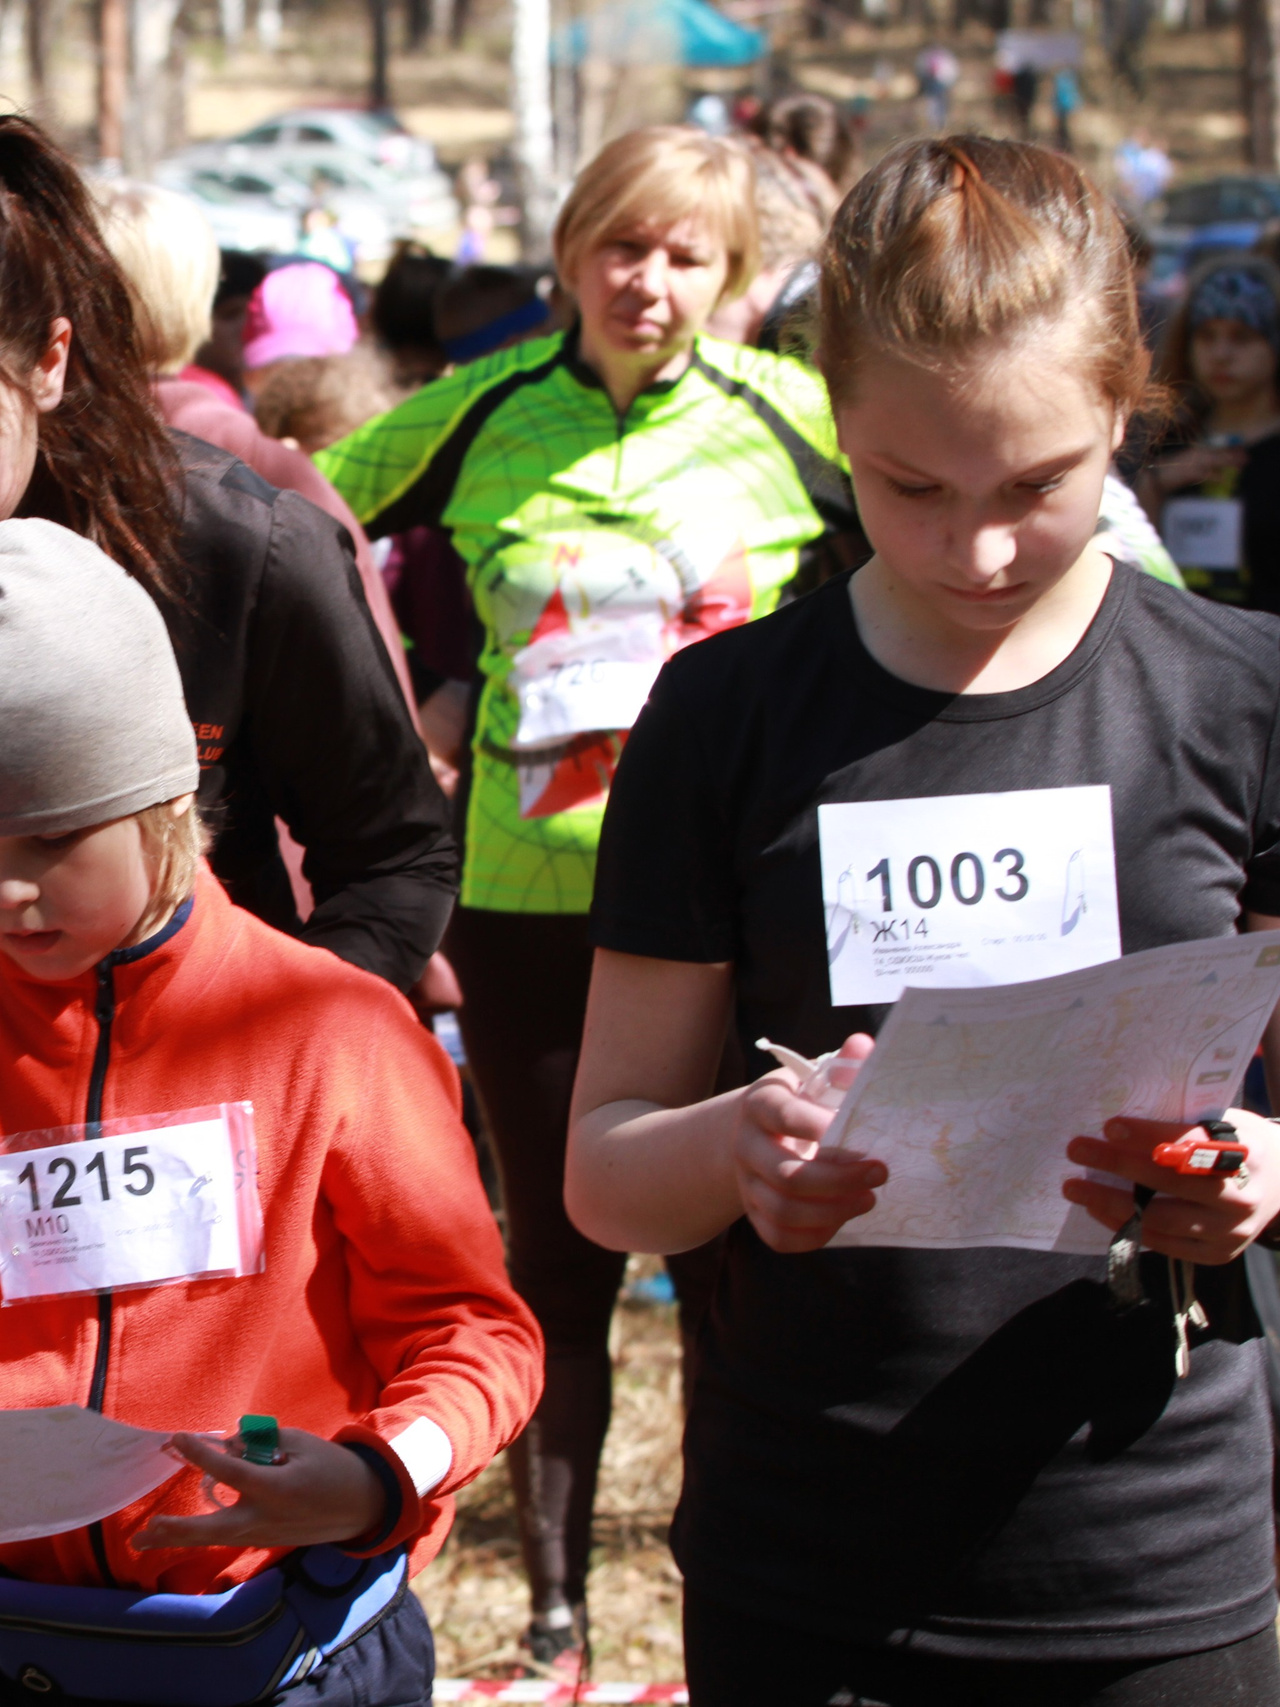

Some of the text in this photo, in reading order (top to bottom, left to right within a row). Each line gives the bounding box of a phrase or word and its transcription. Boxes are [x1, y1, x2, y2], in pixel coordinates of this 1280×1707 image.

[866, 847, 1030, 913] 1003
[870, 917, 929, 942] Ж14
[18, 1145, 156, 1212] 1215
